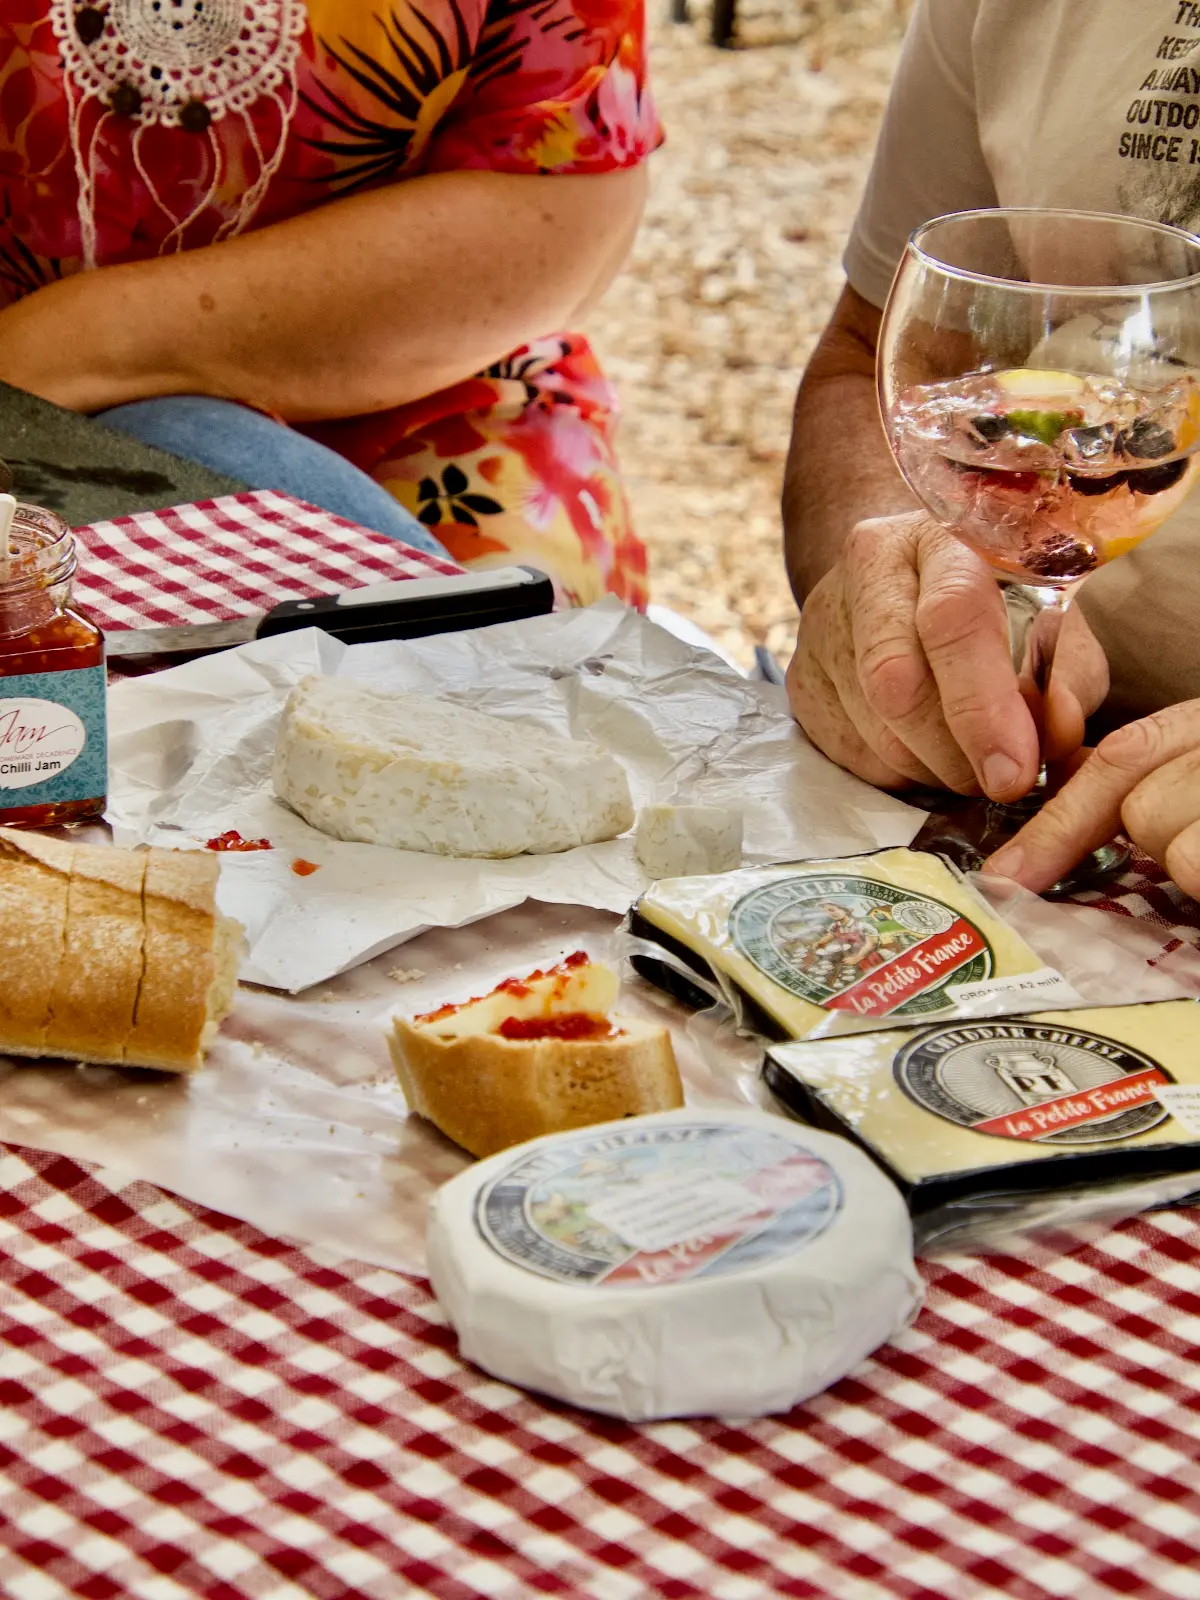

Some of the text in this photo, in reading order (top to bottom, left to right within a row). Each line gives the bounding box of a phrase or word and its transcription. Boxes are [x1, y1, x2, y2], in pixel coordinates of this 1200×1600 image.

[1174, 0, 1200, 28] TH
[1118, 131, 1183, 163] SINCE
[0, 753, 33, 762] OMEMADE
[0, 761, 61, 774] Chilli Jam
[850, 996, 877, 1014] La
[868, 965, 921, 1003] Petite
[912, 933, 973, 974] France
[1037, 976, 1062, 988] milk
[925, 1027, 1128, 1060] CHEDDAR CHEESE
[1005, 1119, 1033, 1136] La
[1029, 1101, 1091, 1129] Petite
